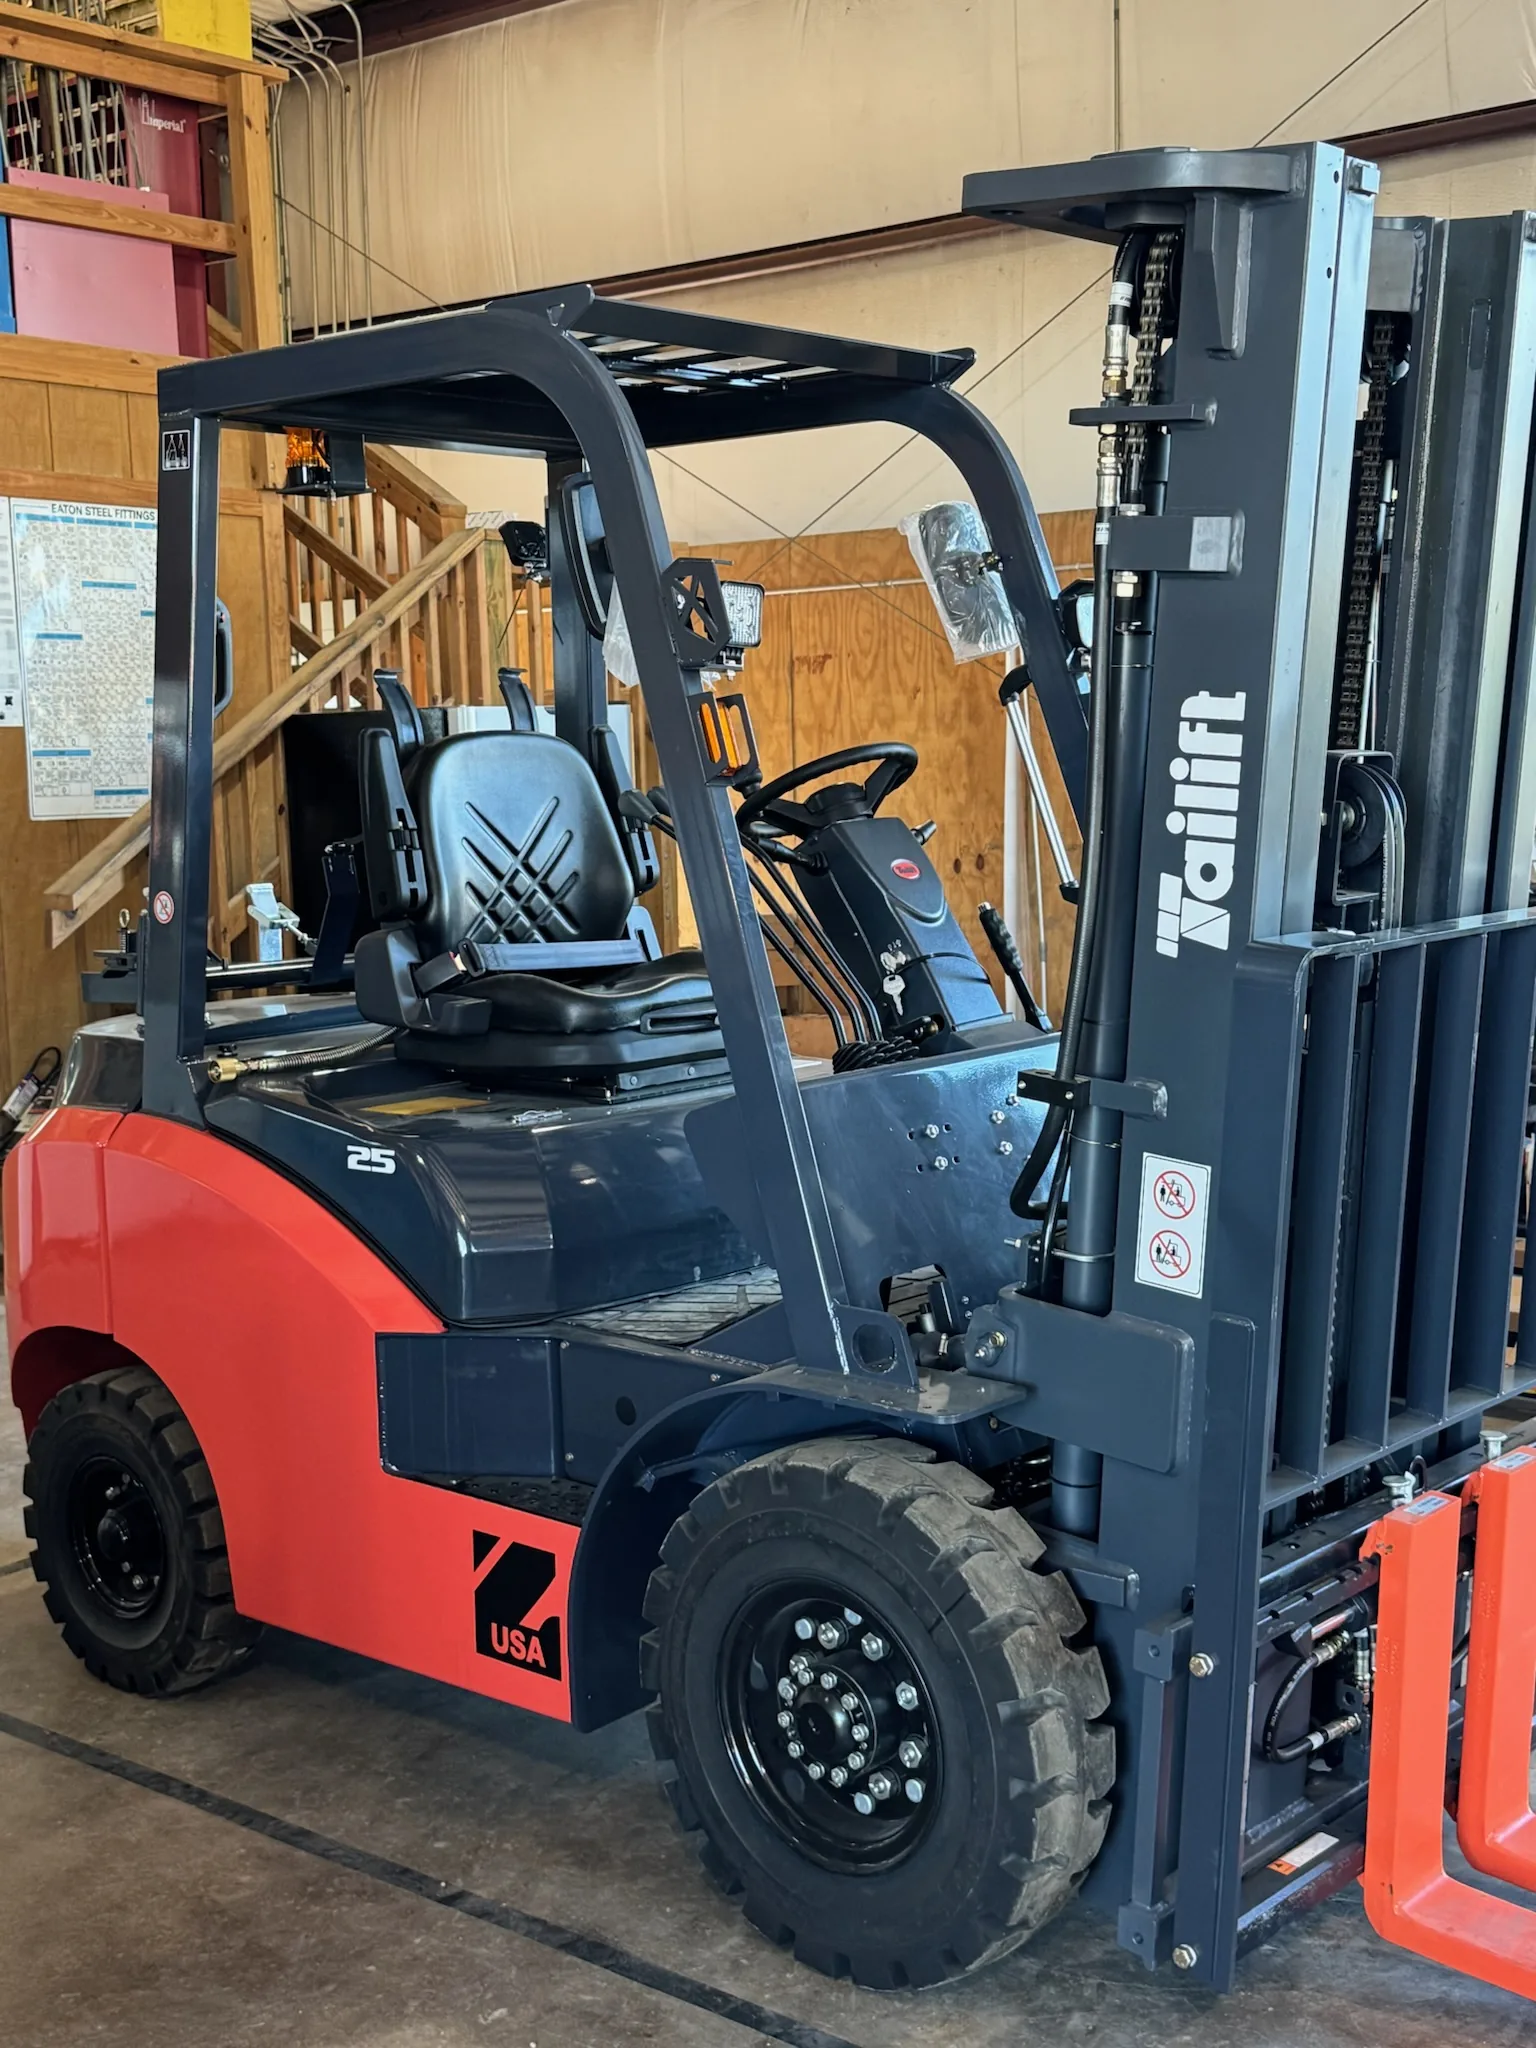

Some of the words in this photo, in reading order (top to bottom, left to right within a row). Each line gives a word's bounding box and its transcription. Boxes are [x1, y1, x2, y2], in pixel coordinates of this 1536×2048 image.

[51, 503, 83, 515] EATON
[85, 506, 113, 518] STEEL
[115, 508, 156, 521] FITTINGS
[1155, 690, 1247, 959] Tailift
[346, 1144, 397, 1175] 25
[491, 1621, 547, 1669] USA
